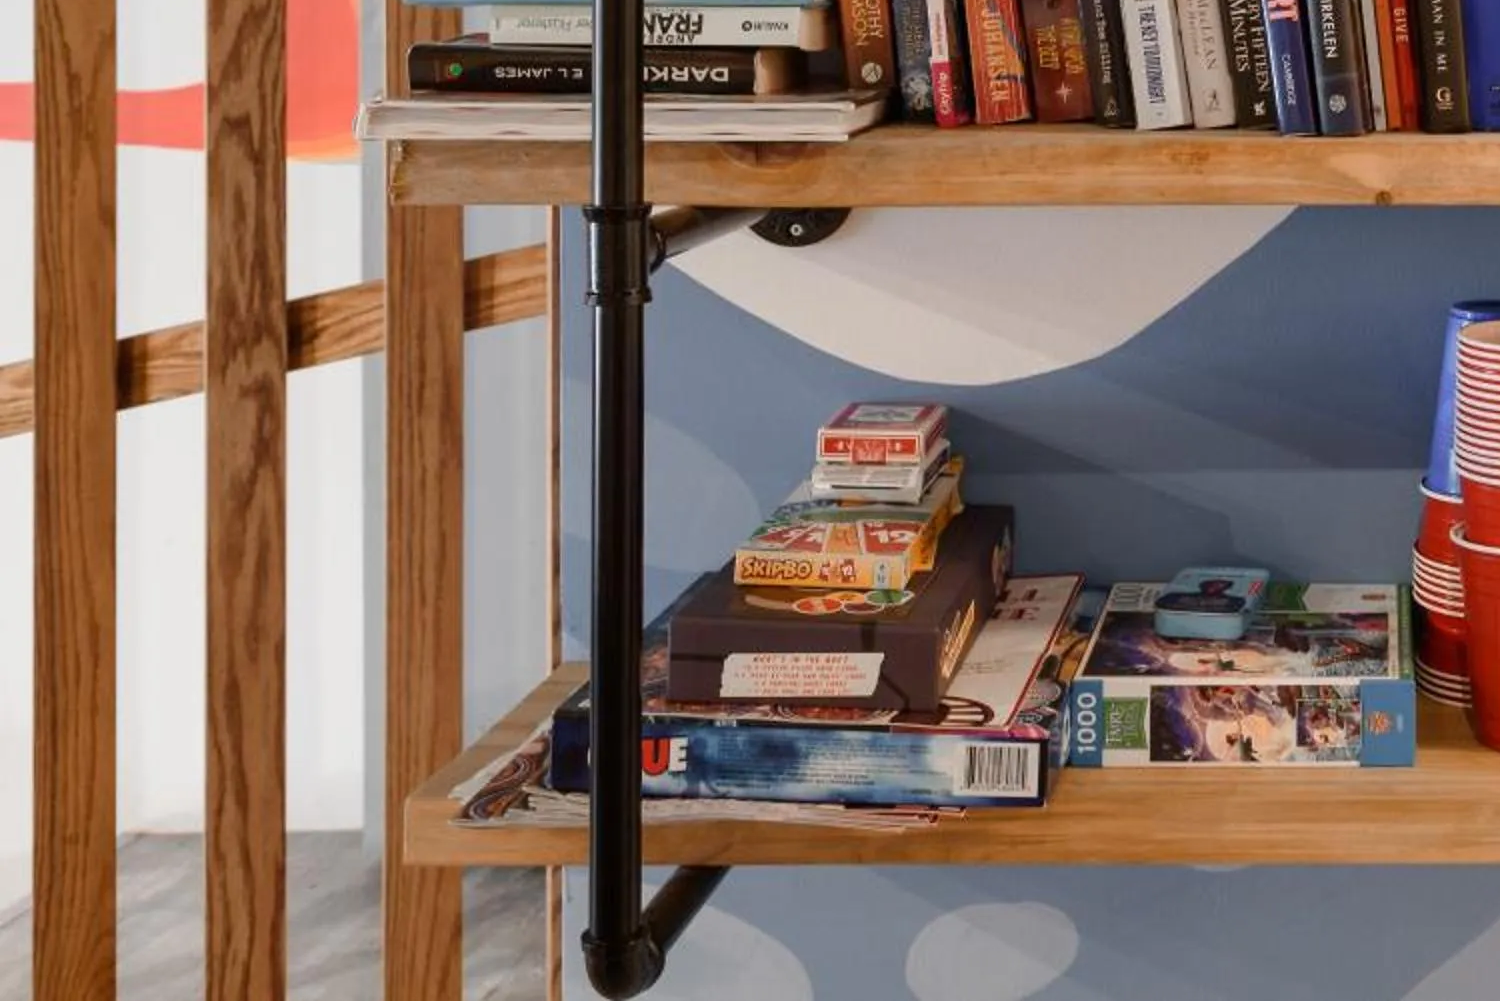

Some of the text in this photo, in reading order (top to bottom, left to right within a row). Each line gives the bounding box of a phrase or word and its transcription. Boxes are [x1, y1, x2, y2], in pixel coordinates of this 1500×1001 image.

[1139, 5, 1155, 23] THE
[643, 14, 704, 35] FRAN
[1393, 7, 1409, 43] GIVE
[645, 34, 695, 44] ANDRE
[1435, 30, 1445, 47] IN
[979, 5, 1011, 103] JOHANSEN
[1249, 26, 1271, 92] FIFTEEN
[1437, 54, 1448, 72] ME
[495, 66, 584, 79] E L JAMES
[643, 65, 729, 82] DARK
[1077, 692, 1097, 755] 1000
[641, 737, 689, 775] UE
